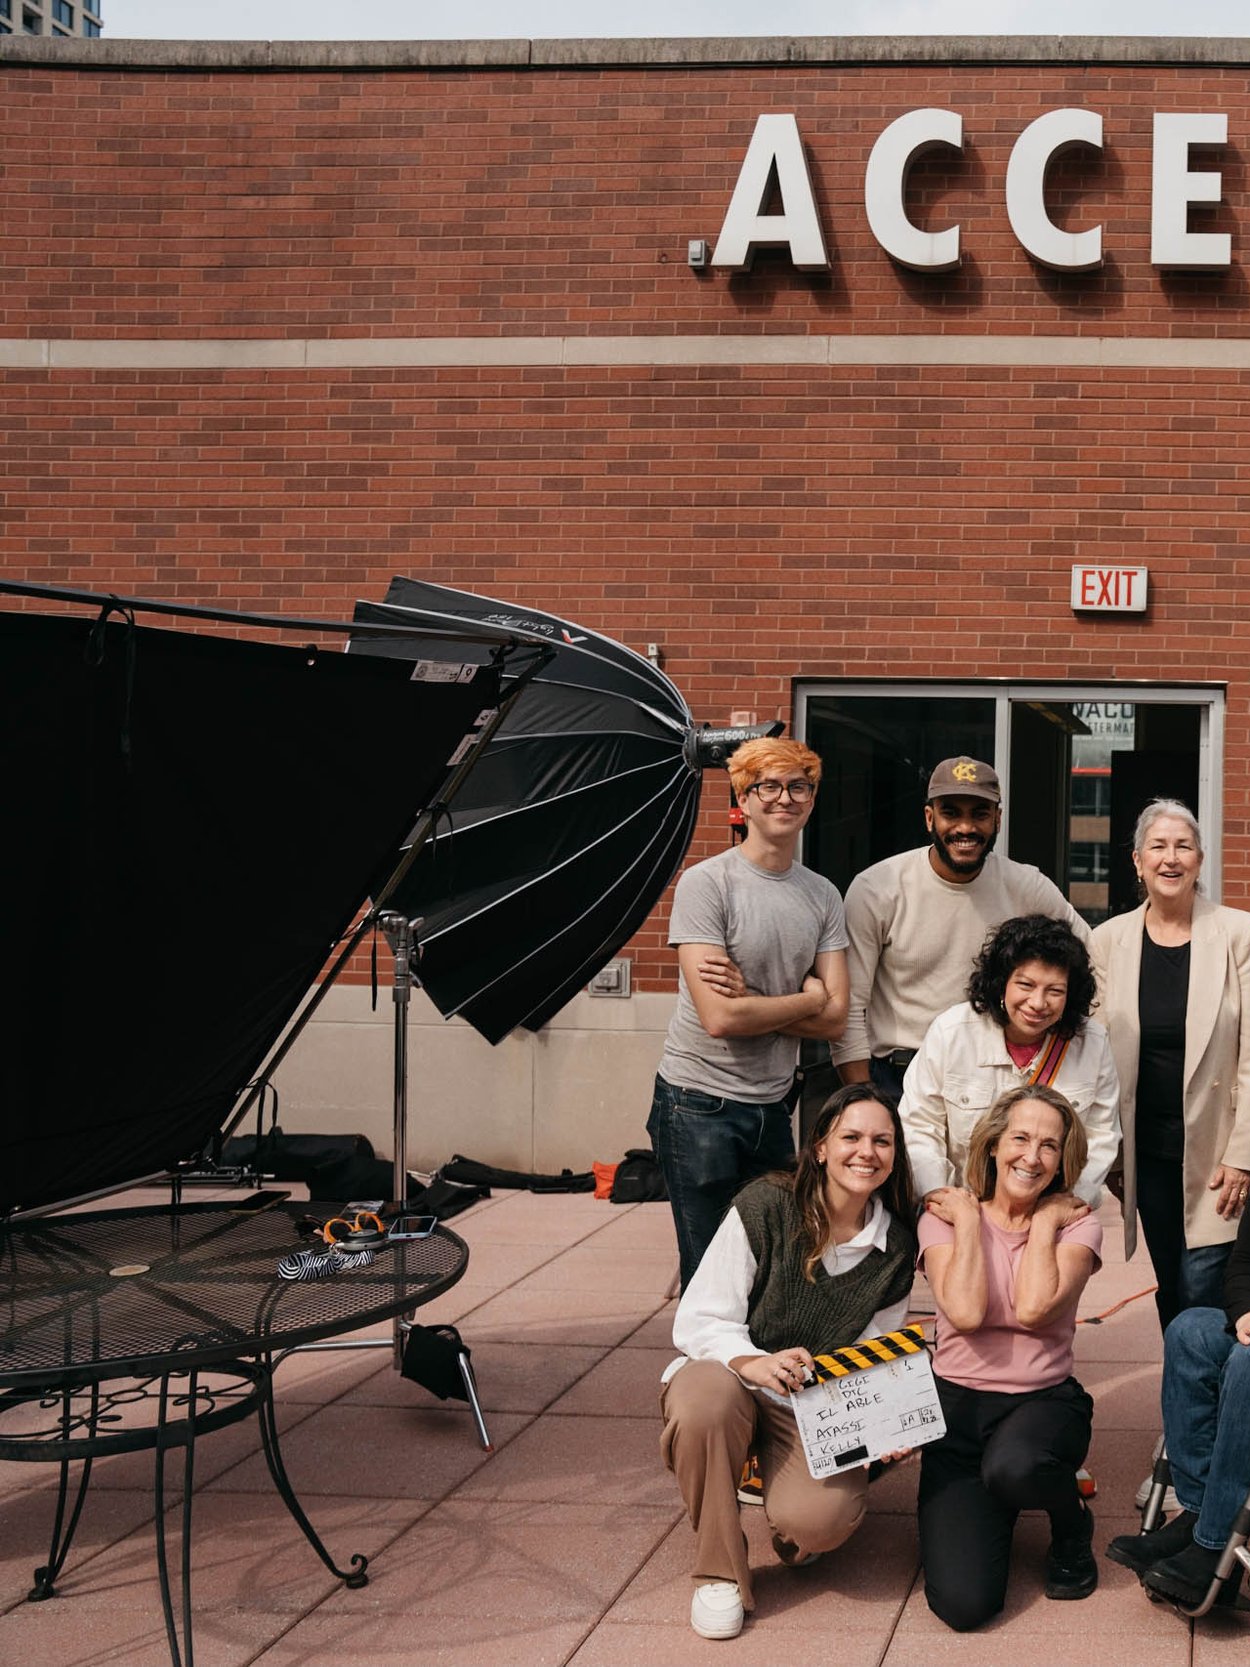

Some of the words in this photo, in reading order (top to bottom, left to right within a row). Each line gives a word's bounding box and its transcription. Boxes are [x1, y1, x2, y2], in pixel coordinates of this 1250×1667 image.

[1081, 570, 1138, 606] EXIT
[846, 1392, 885, 1412] ABLE
[816, 1418, 867, 1440] ATASSI
[820, 1435, 861, 1455] KELLY
